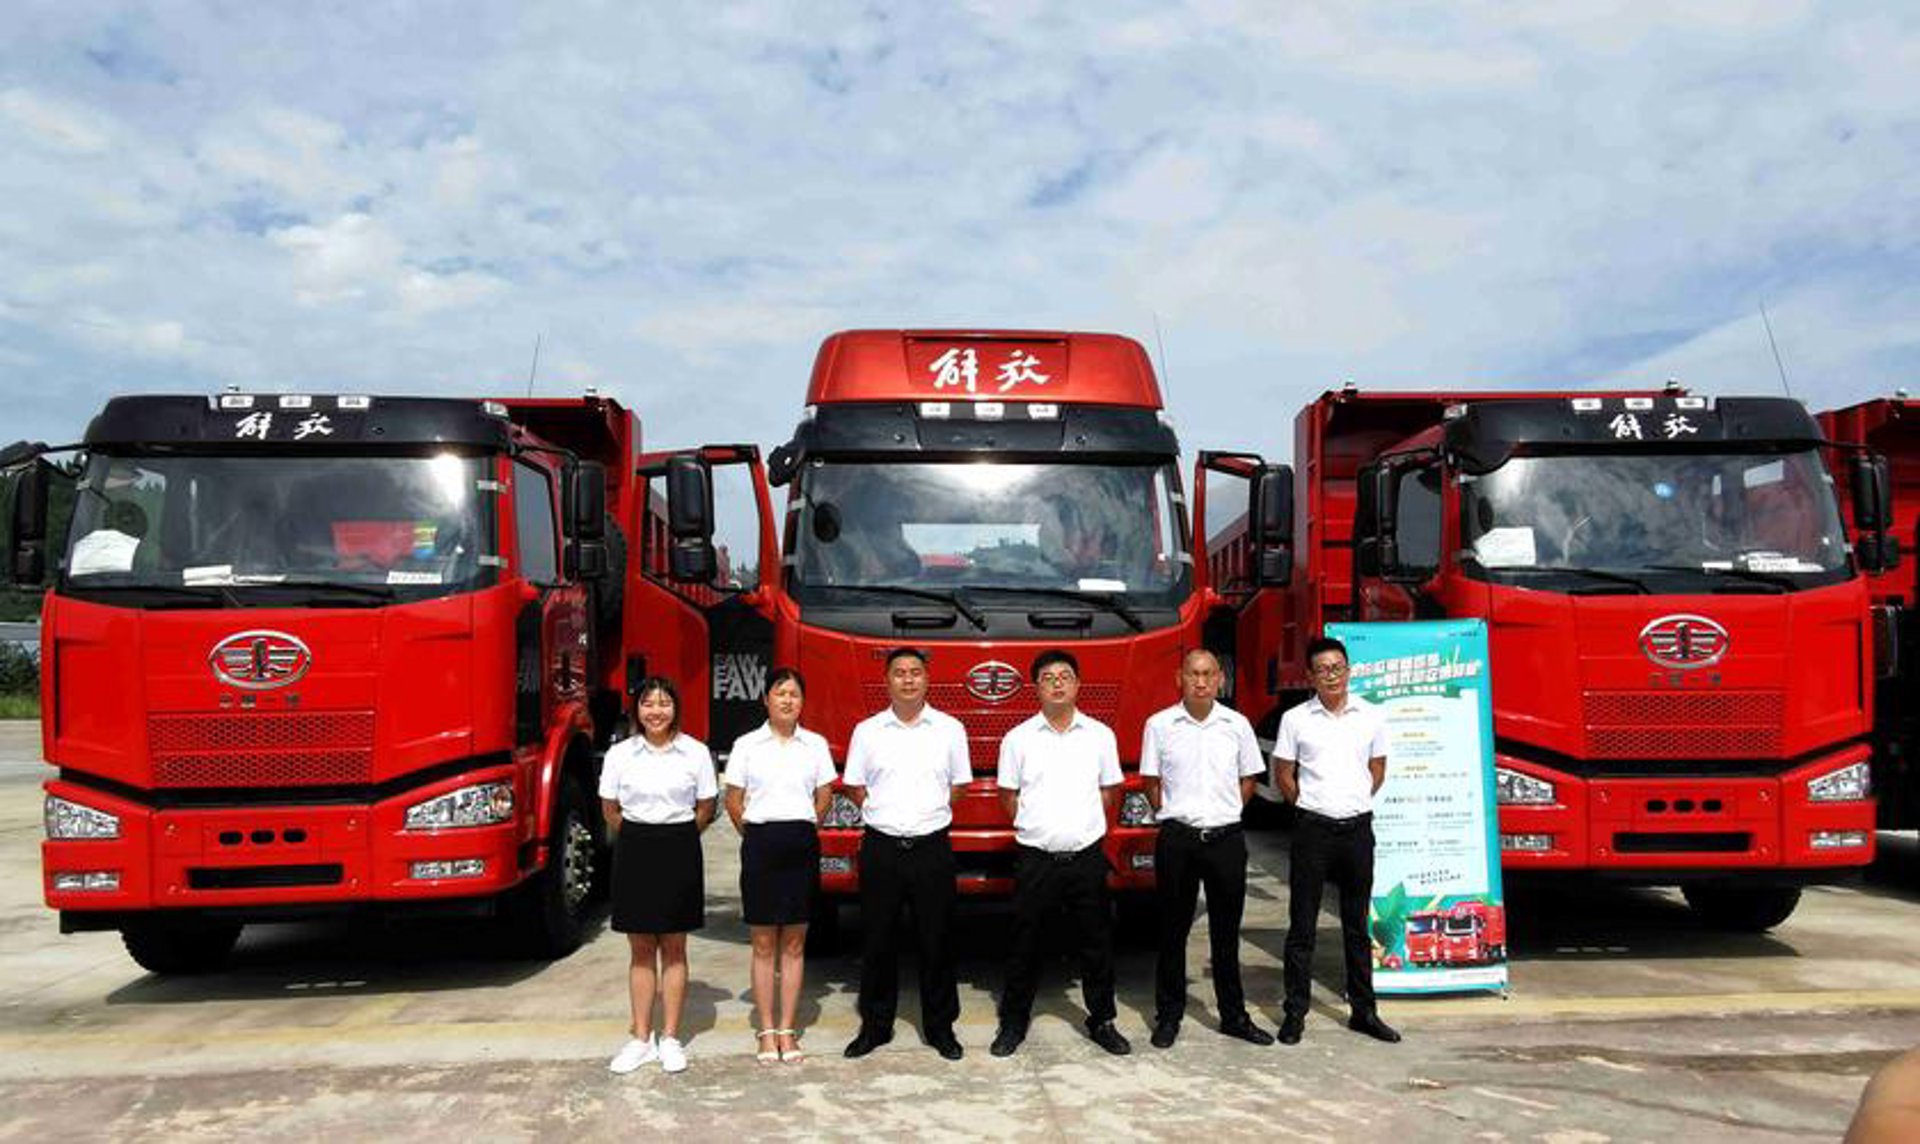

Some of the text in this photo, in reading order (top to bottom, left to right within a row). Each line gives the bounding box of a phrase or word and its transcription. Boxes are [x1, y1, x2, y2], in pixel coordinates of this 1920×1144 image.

[929, 348, 1050, 392] 解放
[236, 412, 333, 440] 解放
[1609, 414, 1698, 440] 解放
[713, 679, 769, 700] FAW
